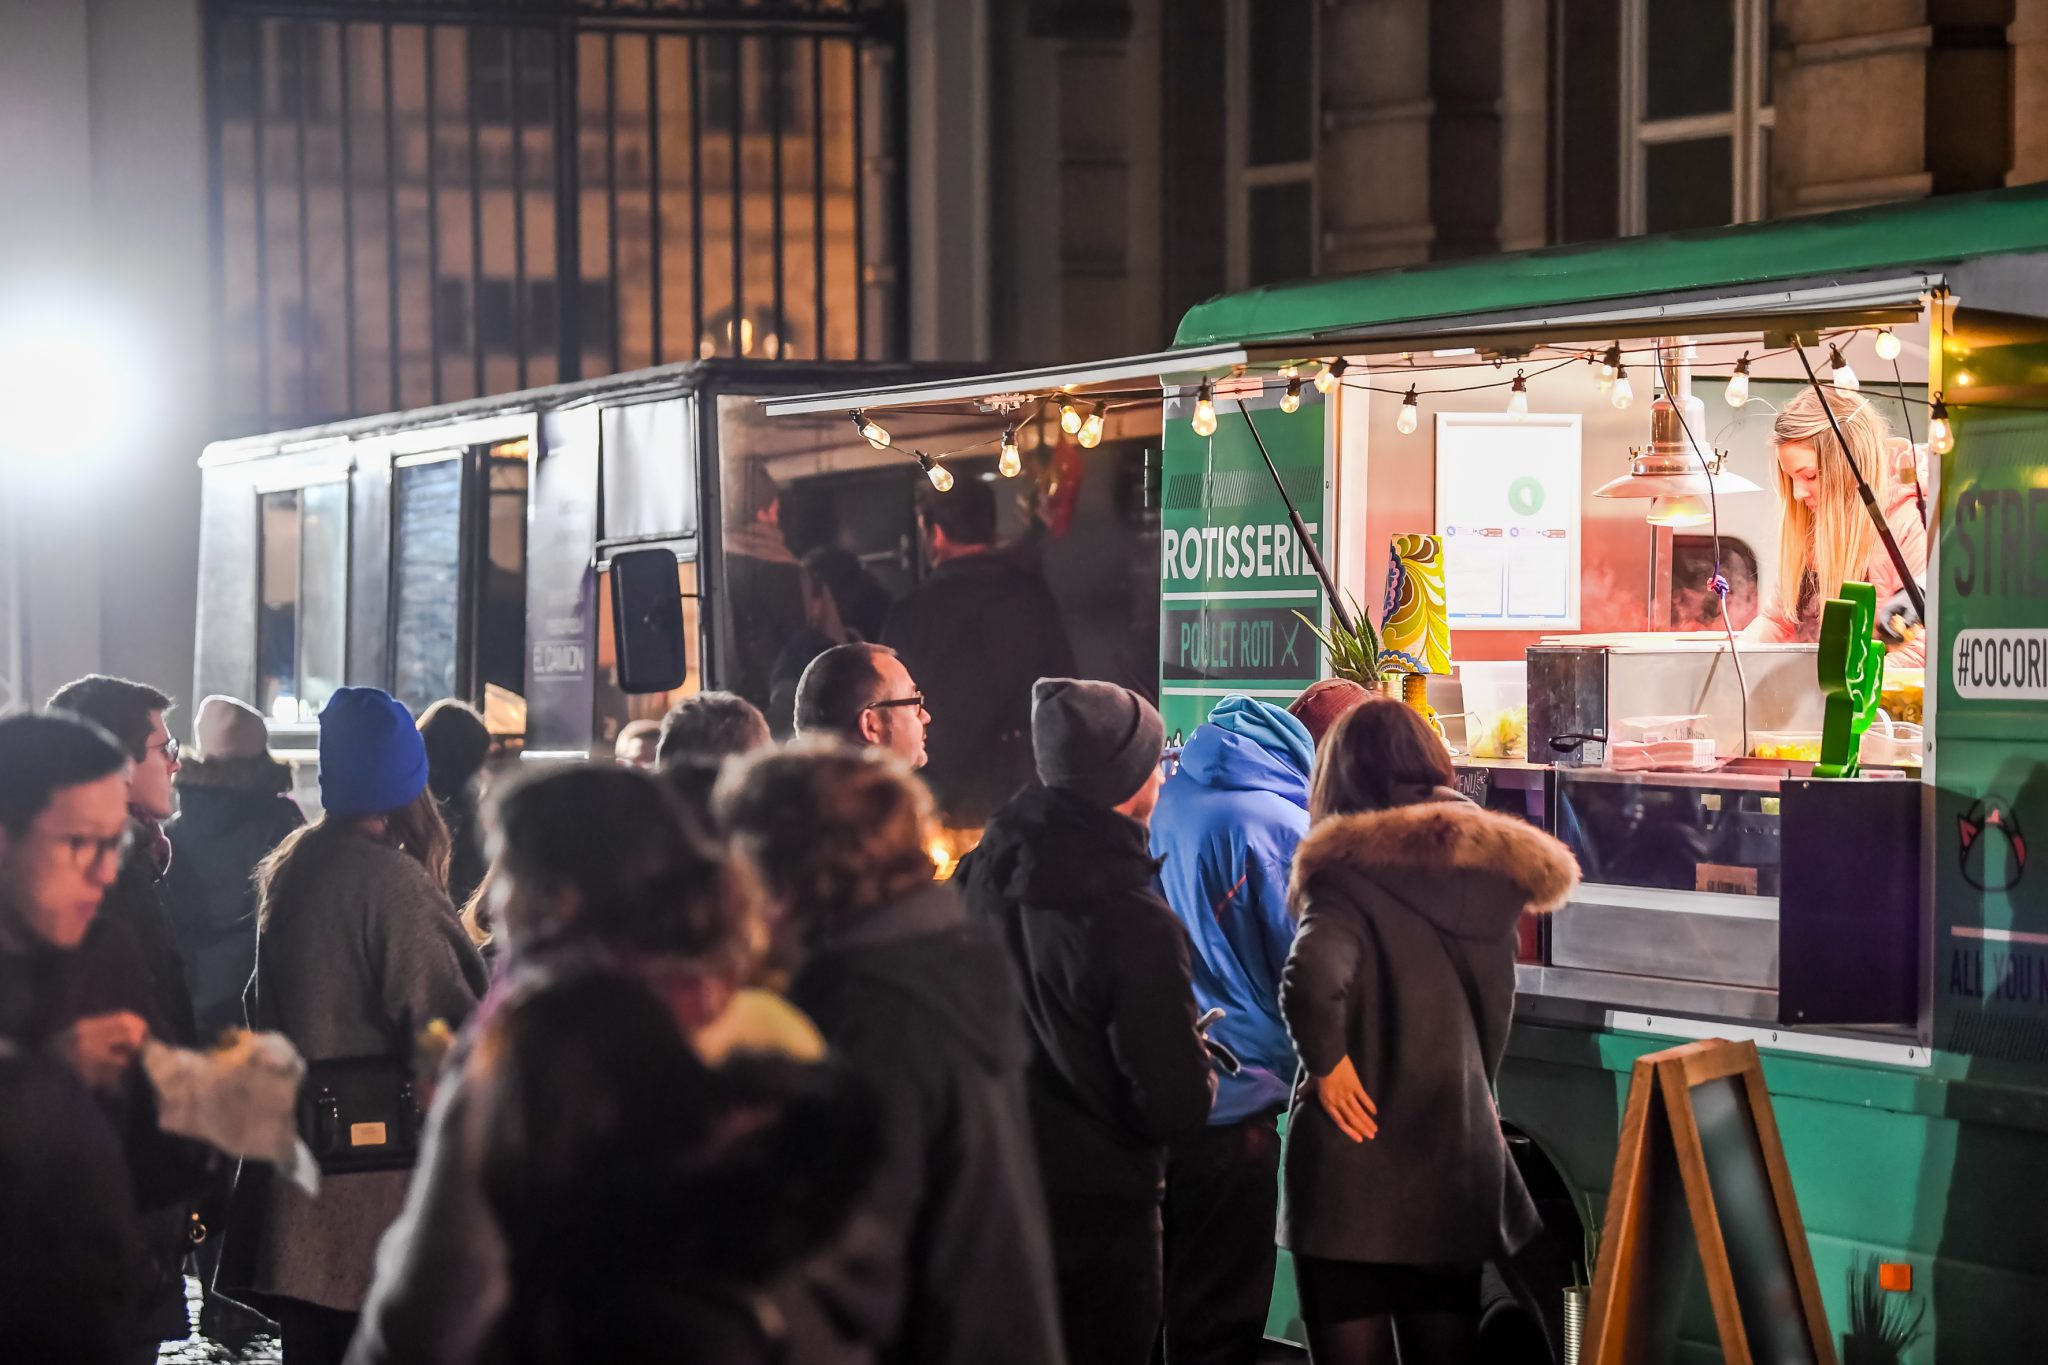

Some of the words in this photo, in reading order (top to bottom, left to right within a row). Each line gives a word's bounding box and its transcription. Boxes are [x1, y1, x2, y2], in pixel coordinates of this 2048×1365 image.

[1163, 523, 1318, 580] ROTISSERIE
[1181, 621, 1237, 668] POULET
[1241, 620, 1274, 668] ROTI
[1958, 638, 2047, 688] #COCORI
[1950, 949, 1983, 997] ALL
[1993, 952, 2032, 1001] YOU
